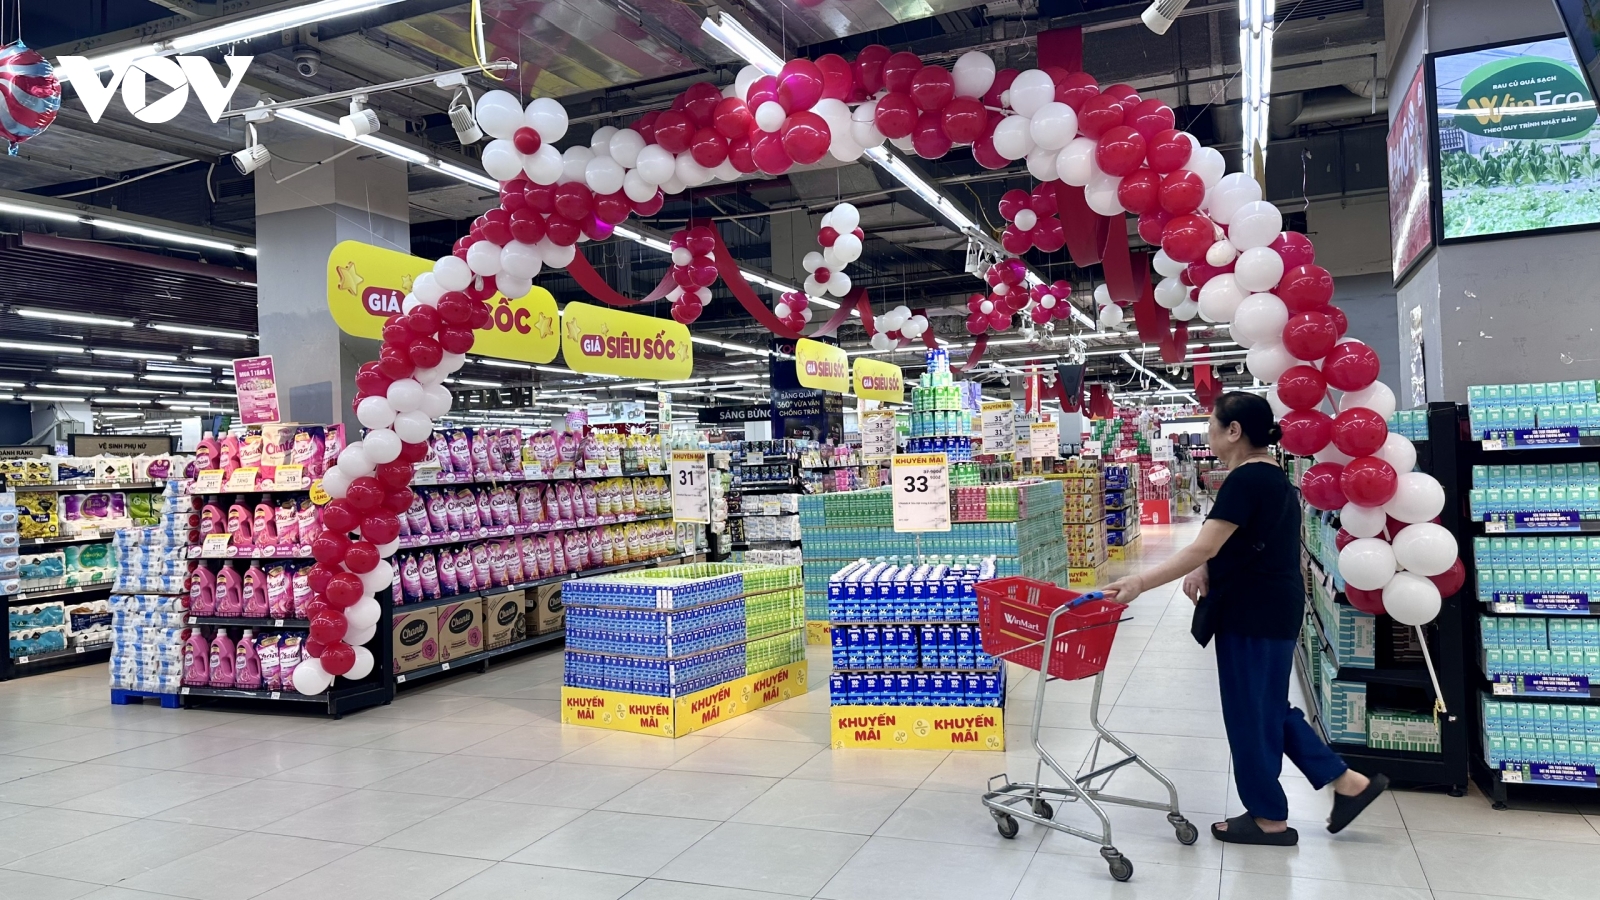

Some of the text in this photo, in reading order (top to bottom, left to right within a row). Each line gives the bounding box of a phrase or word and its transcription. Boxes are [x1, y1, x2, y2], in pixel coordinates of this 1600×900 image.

[1520, 78, 1535, 86] QUẢ
[1468, 90, 1583, 125] WinEco
[1519, 120, 1540, 129] TRÌNH
[368, 290, 400, 313] GIÁ
[584, 330, 676, 361] GIÁ SIÊU SỐC
[806, 357, 844, 378] GIÁ SIÊU SỐC
[863, 373, 899, 391] GIÁ SIÊU SỐC
[720, 410, 745, 419] SÁNG
[679, 470, 694, 485] 31
[904, 476, 928, 492] 33
[451, 611, 470, 628] Chanté
[1004, 612, 1039, 631] WinMart
[402, 622, 425, 639] Chanté
[753, 669, 788, 693] KHUYẾN
[567, 695, 604, 708] KHUYẾN
[691, 687, 730, 714] KHUYẾN
[763, 687, 779, 703] MÃI
[577, 709, 594, 720] MÃI
[629, 703, 669, 716] KHUYẾN
[702, 708, 720, 724] MÃI
[640, 716, 658, 728] MÃI
[838, 713, 895, 729] KHUYẾN
[934, 714, 994, 730] KHUYẾN
[855, 728, 880, 741] MÃI
[952, 729, 978, 743] MÃI
